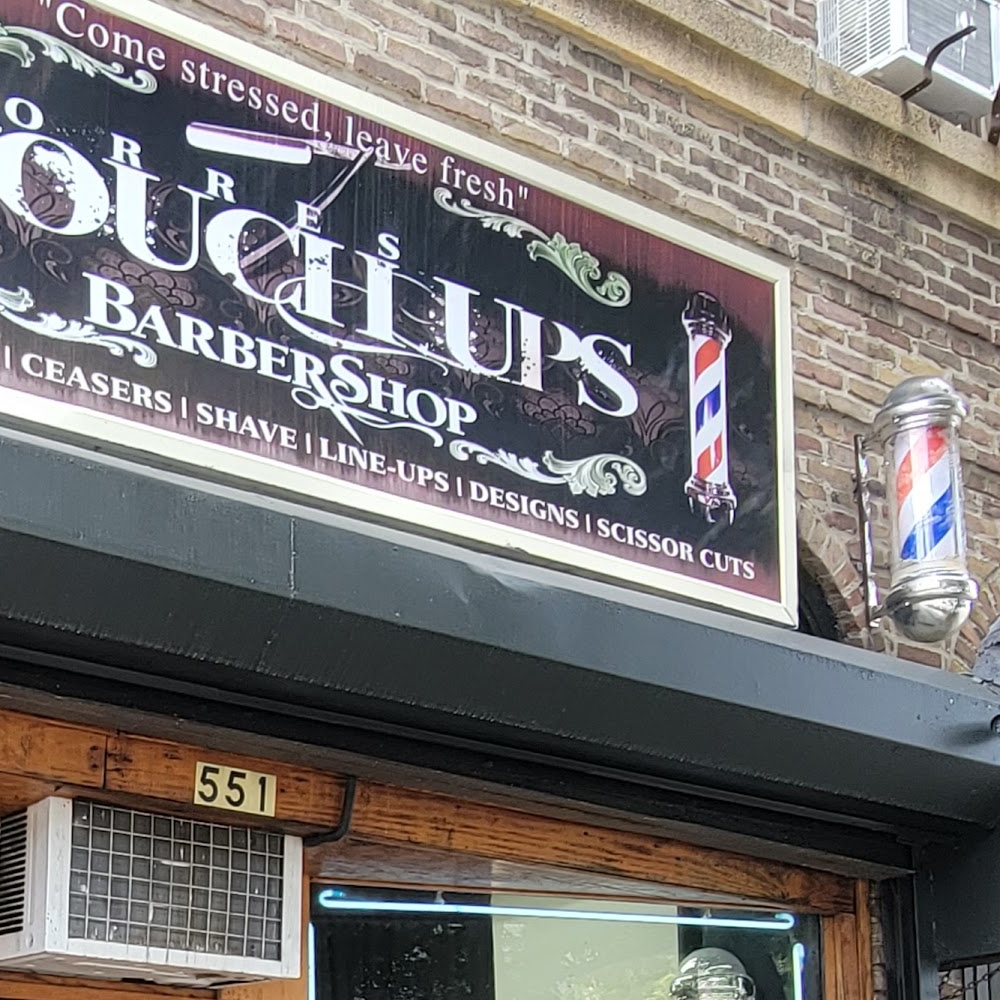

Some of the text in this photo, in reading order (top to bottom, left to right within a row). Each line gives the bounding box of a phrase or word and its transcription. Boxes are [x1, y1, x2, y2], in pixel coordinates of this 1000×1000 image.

[181, 59, 332, 145] stressed,
[344, 114, 429, 175] leave
[440, 155, 529, 210] fresh"
[434, 274, 641, 418] UPS
[20, 351, 173, 414] CEASERS
[196, 401, 298, 450] SHAVE
[319, 435, 450, 493] LINE-UPS
[469, 479, 580, 530] DESIGNS
[597, 517, 695, 563] SCISSOR
[700, 547, 756, 580] CUTS
[198, 765, 267, 812] 551
